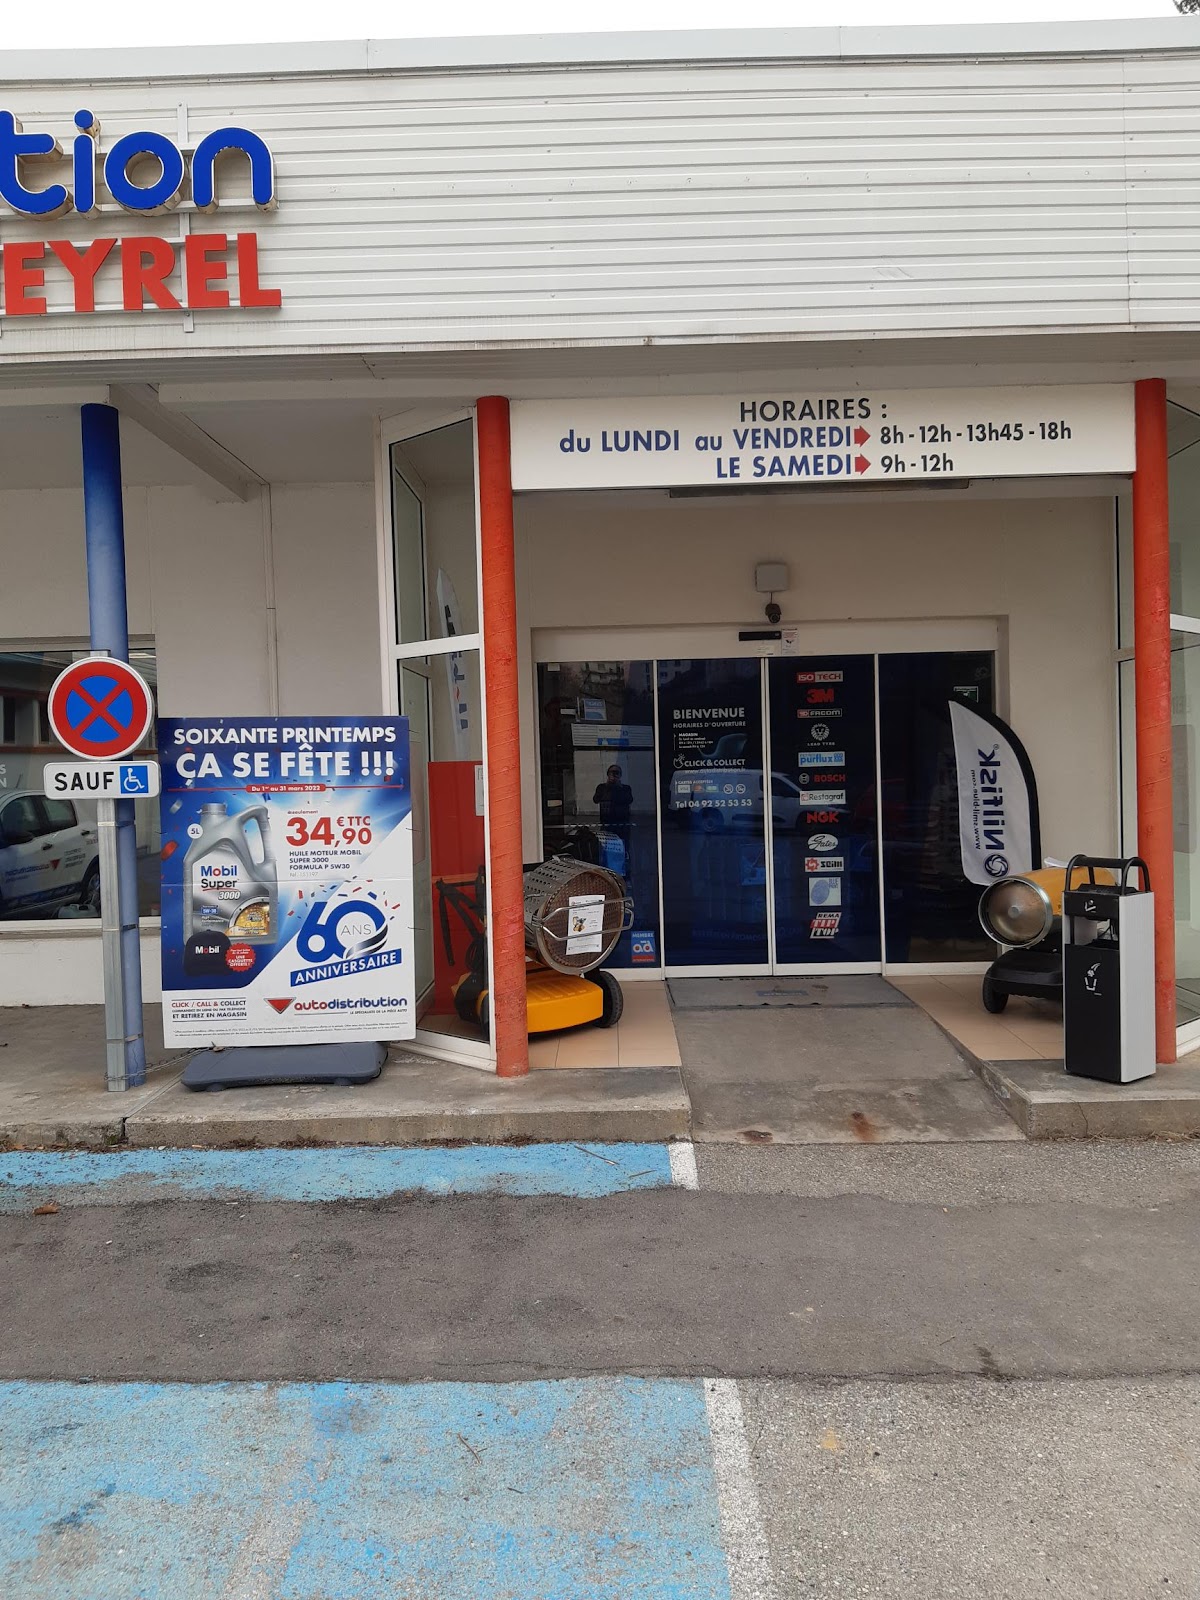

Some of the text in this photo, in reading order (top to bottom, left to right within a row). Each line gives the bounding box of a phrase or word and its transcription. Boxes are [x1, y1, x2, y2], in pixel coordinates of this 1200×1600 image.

[3, 232, 282, 315] EYREL
[740, 398, 871, 422] HORAIRES
[559, 429, 591, 453] du
[601, 429, 680, 452] LUNDI
[695, 435, 722, 451] au
[732, 426, 851, 450] VENDREDI
[717, 456, 740, 478] LE
[753, 454, 851, 478] SAMEDI
[806, 688, 835, 703] 3M
[673, 707, 745, 719] BIENVENUE
[173, 726, 397, 745] SOIXANTE PRINTEMPS
[232, 752, 270, 777] SE
[280, 742, 350, 777] FÊTE
[361, 750, 395, 776] !!!
[800, 753, 833, 766] purflux
[54, 771, 115, 792] SAUF
[814, 774, 846, 782] BOSCH
[809, 792, 844, 802] Restagraf
[347, 815, 371, 826] TTC
[806, 810, 839, 824] NGK
[808, 836, 836, 850] Gates
[200, 865, 237, 877] Mobil
[201, 878, 238, 890] Super
[218, 891, 241, 900] 3000
[341, 923, 372, 936] ANS
[811, 919, 836, 928] TIP
[815, 928, 839, 937] TOP
[195, 946, 221, 954] Mobil
[294, 951, 398, 985] ANNIVERSAIRE
[294, 996, 408, 1011] autodistribution
